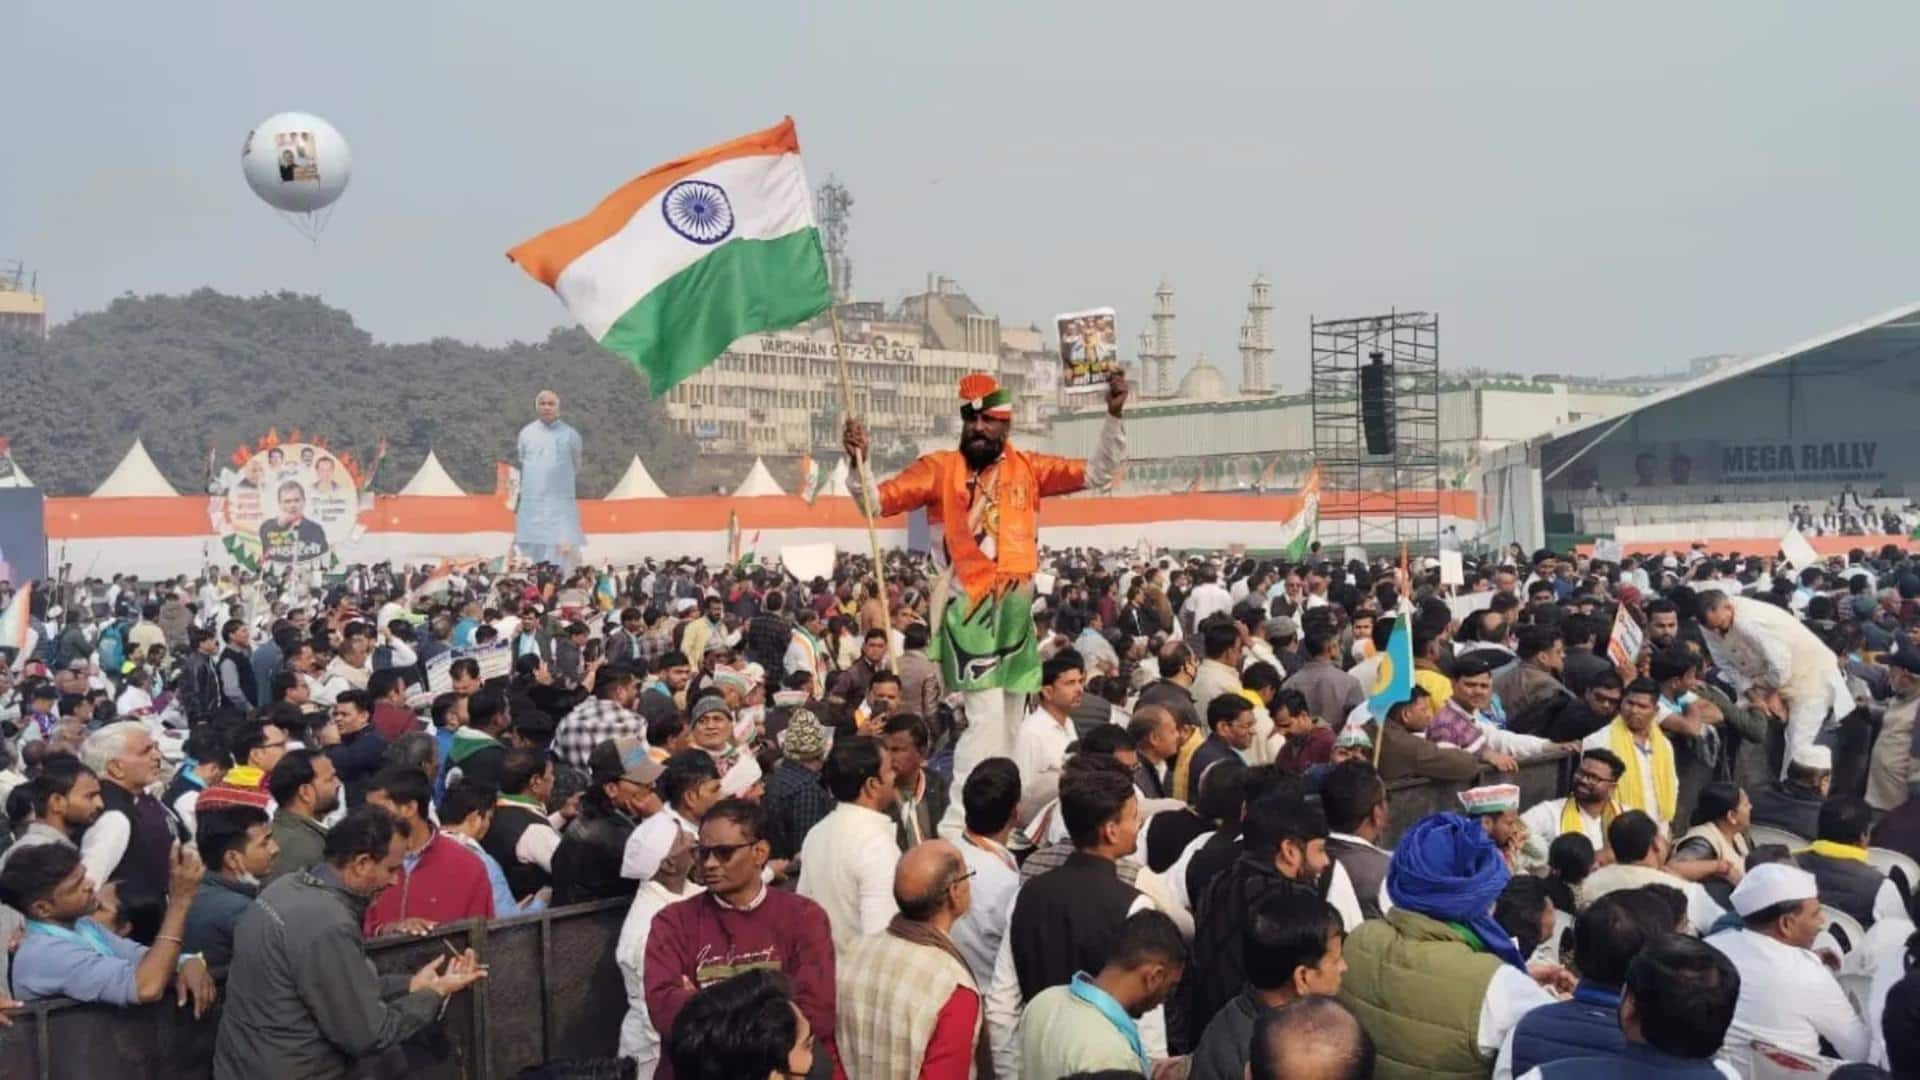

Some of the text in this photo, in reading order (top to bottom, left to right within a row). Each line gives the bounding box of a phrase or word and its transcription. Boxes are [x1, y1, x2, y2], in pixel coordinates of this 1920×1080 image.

[760, 338, 915, 362] VARDHMAN CTY-2 PLAZA
[1722, 441, 1877, 472] MEGA RALLY
